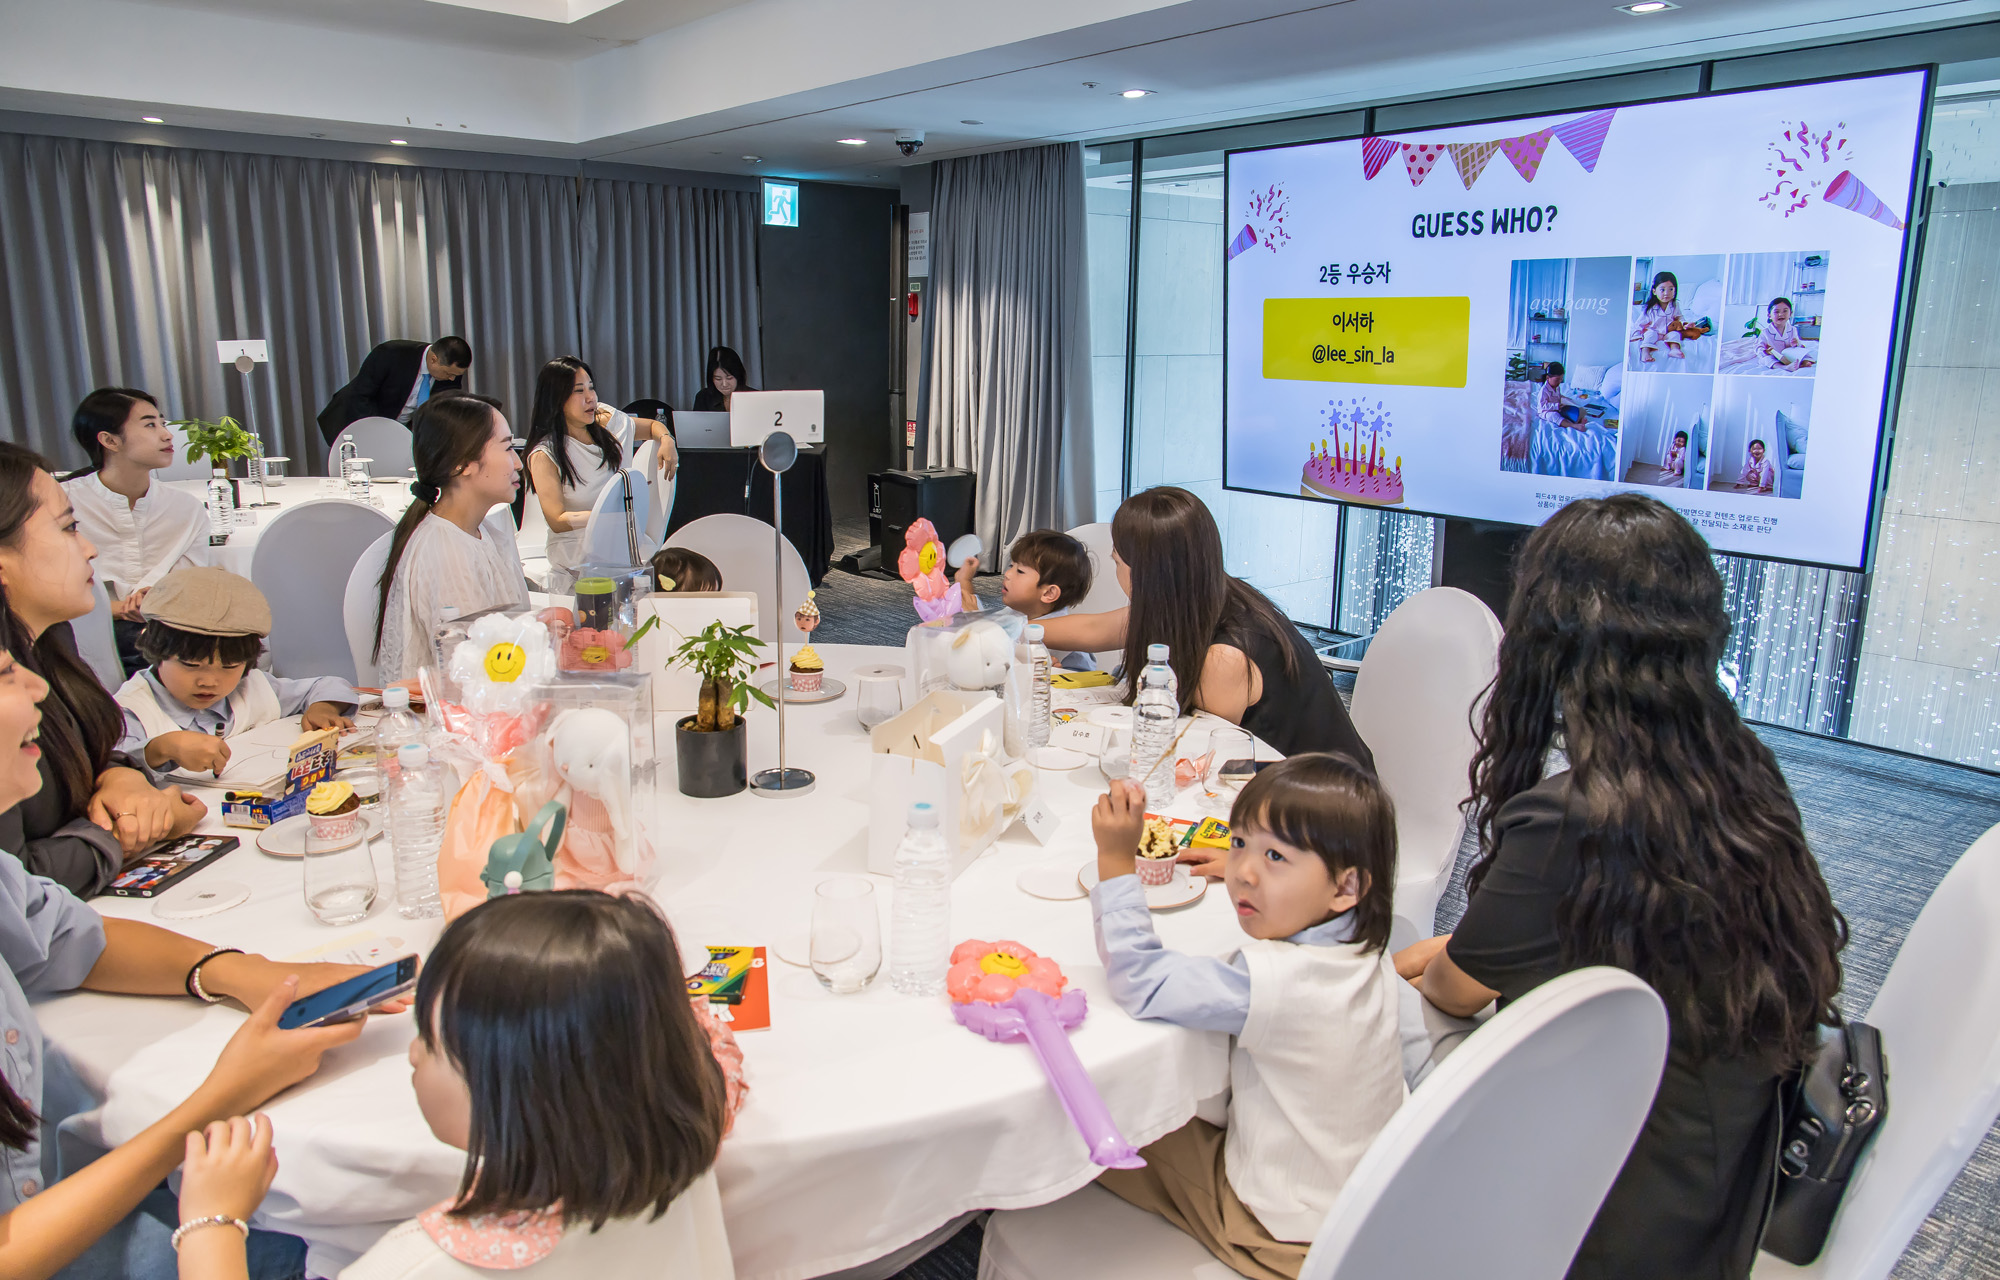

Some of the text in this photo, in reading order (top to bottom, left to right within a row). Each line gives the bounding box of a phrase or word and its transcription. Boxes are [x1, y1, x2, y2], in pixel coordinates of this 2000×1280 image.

[1412, 205, 1558, 238] GUESS WHO?
[1319, 261, 1391, 285] 2등 우승자
[1332, 311, 1375, 333] 이서하
[1312, 344, 1395, 365] @lee_sin_la
[774, 411, 783, 426] 2
[1701, 519, 1729, 529] 전달되는
[1732, 523, 1754, 532] 소재로
[1756, 525, 1772, 534] 판단
[1714, 511, 1736, 521] 컨텐츠
[1738, 514, 1760, 523] 업로드
[1763, 516, 1778, 525] 진행
[291, 750, 332, 779] 초코쿠키
[302, 768, 326, 786] ABC
